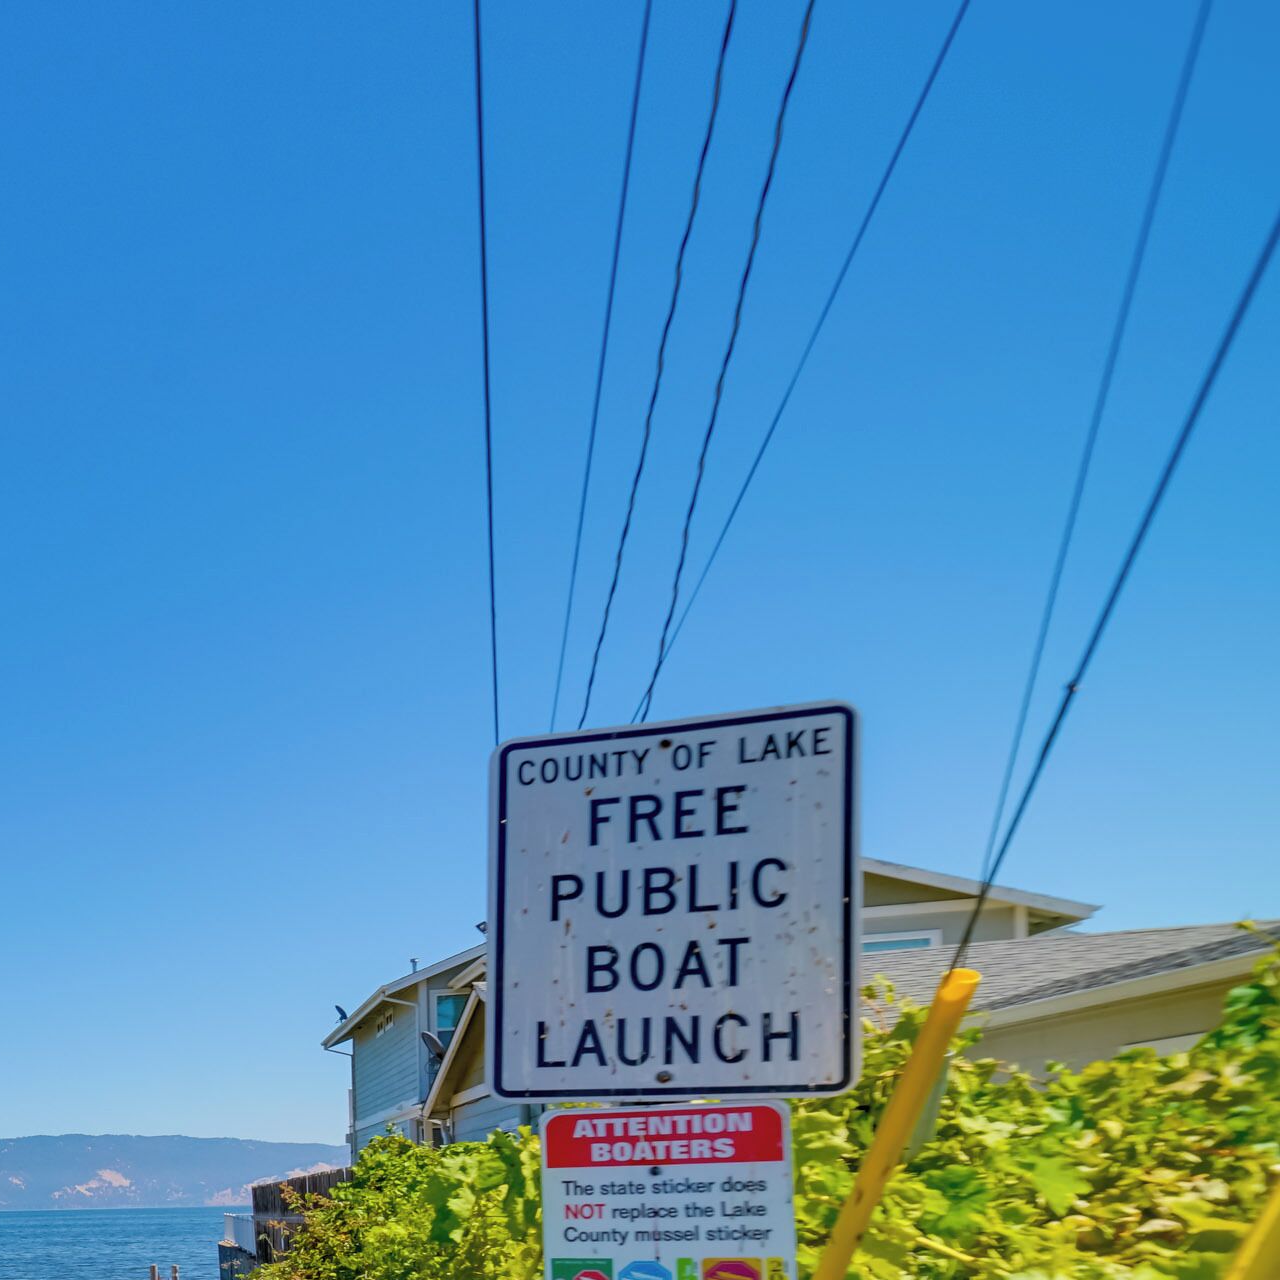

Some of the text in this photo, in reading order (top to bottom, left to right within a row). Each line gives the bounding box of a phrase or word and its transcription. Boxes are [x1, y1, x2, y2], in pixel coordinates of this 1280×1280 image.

[518, 727, 832, 787] COUNTY OF LAKE
[588, 785, 749, 846] FREE
[550, 857, 788, 922] PUBLIC
[586, 937, 751, 993] BOAT
[536, 1011, 800, 1069] LAUNCH
[573, 1112, 753, 1139] ATTENTION
[591, 1138, 736, 1162] BOATERS
[562, 1176, 767, 1196] The state sticker does
[564, 1201, 767, 1222] NOT replace the Lake
[564, 1225, 772, 1246] County mussel sticker
